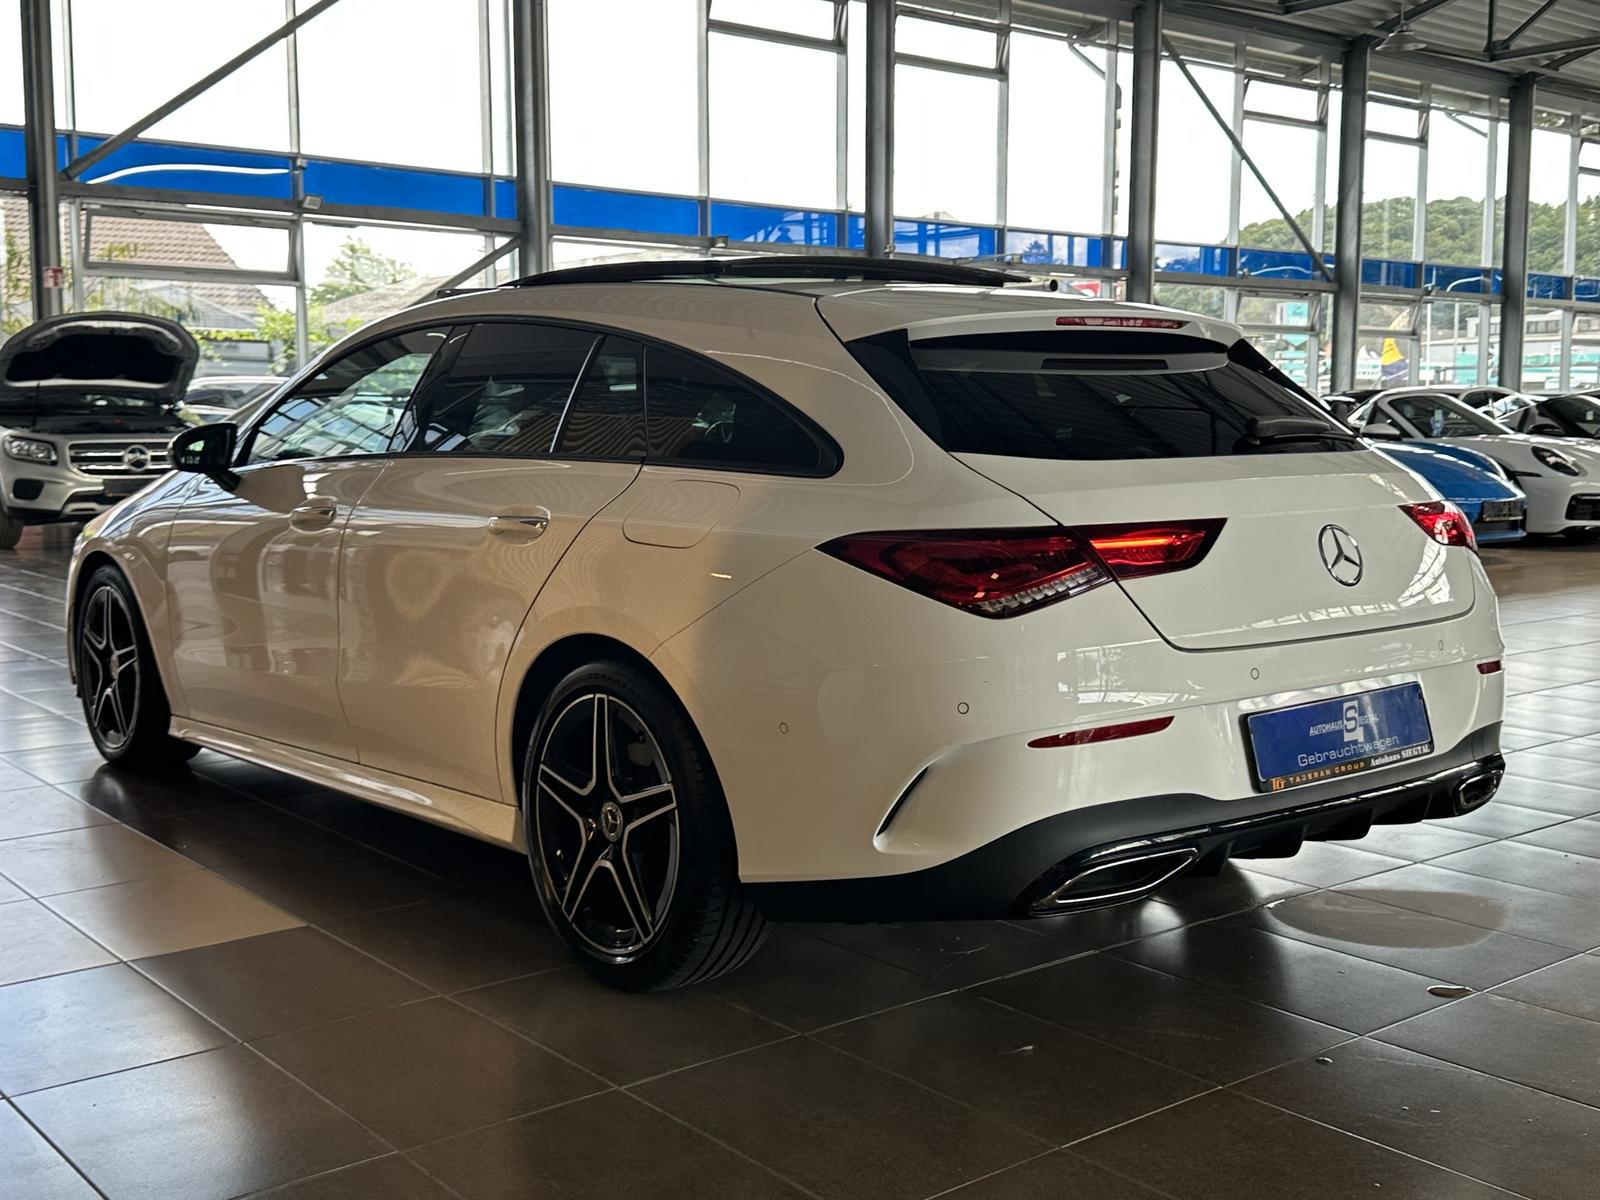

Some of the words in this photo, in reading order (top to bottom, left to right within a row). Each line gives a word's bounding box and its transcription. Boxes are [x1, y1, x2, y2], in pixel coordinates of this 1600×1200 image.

[1309, 719, 1344, 736] AUTOHAUS
[1298, 735, 1399, 767] Gebrauchtwagen
[1335, 762, 1366, 774] GROUP
[1370, 754, 1400, 767] Autohaus
[1401, 744, 1431, 759] SIEGTAL
